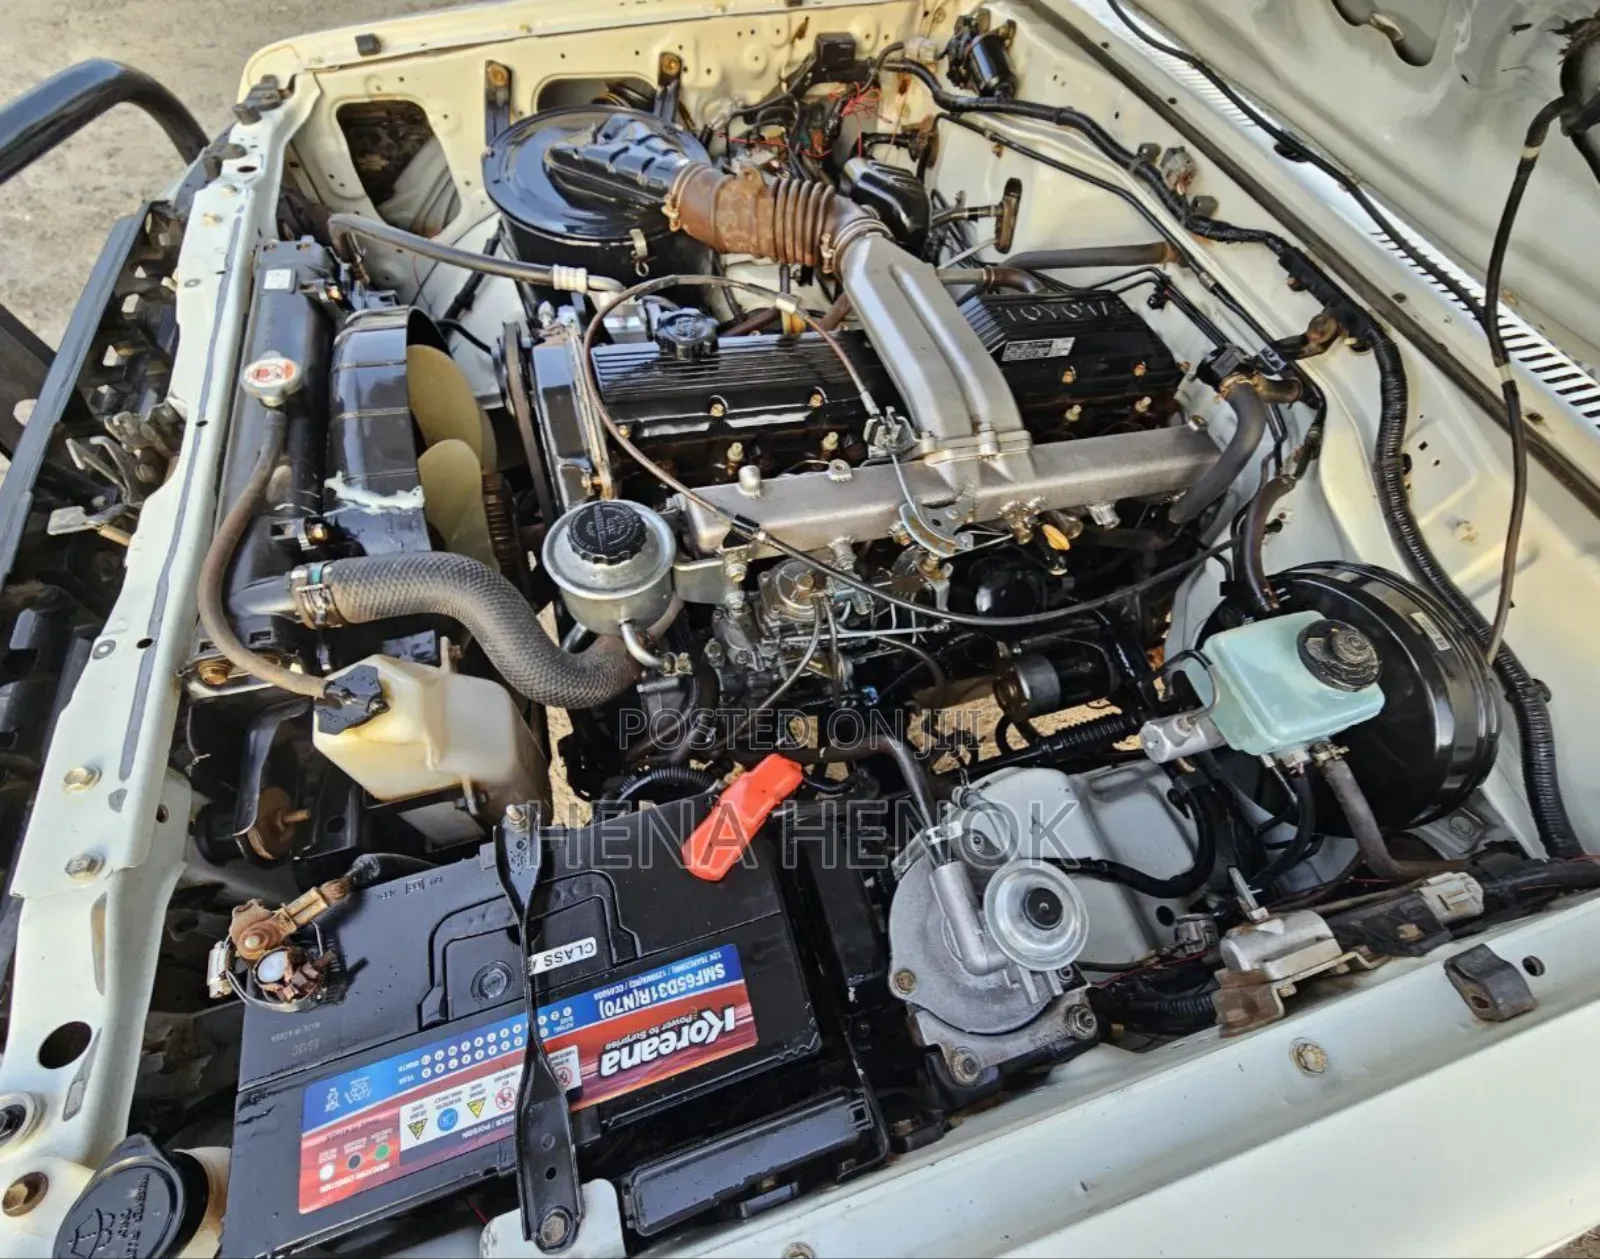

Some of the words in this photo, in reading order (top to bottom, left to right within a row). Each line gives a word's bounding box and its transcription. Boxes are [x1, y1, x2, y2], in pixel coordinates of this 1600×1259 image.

[543, 942, 593, 966] CLASS
[597, 961, 726, 1019] SMF65D31R(N70)
[660, 1013, 693, 1031] Power
[599, 1006, 738, 1077] Koreana
[605, 1030, 647, 1051] Surprise
